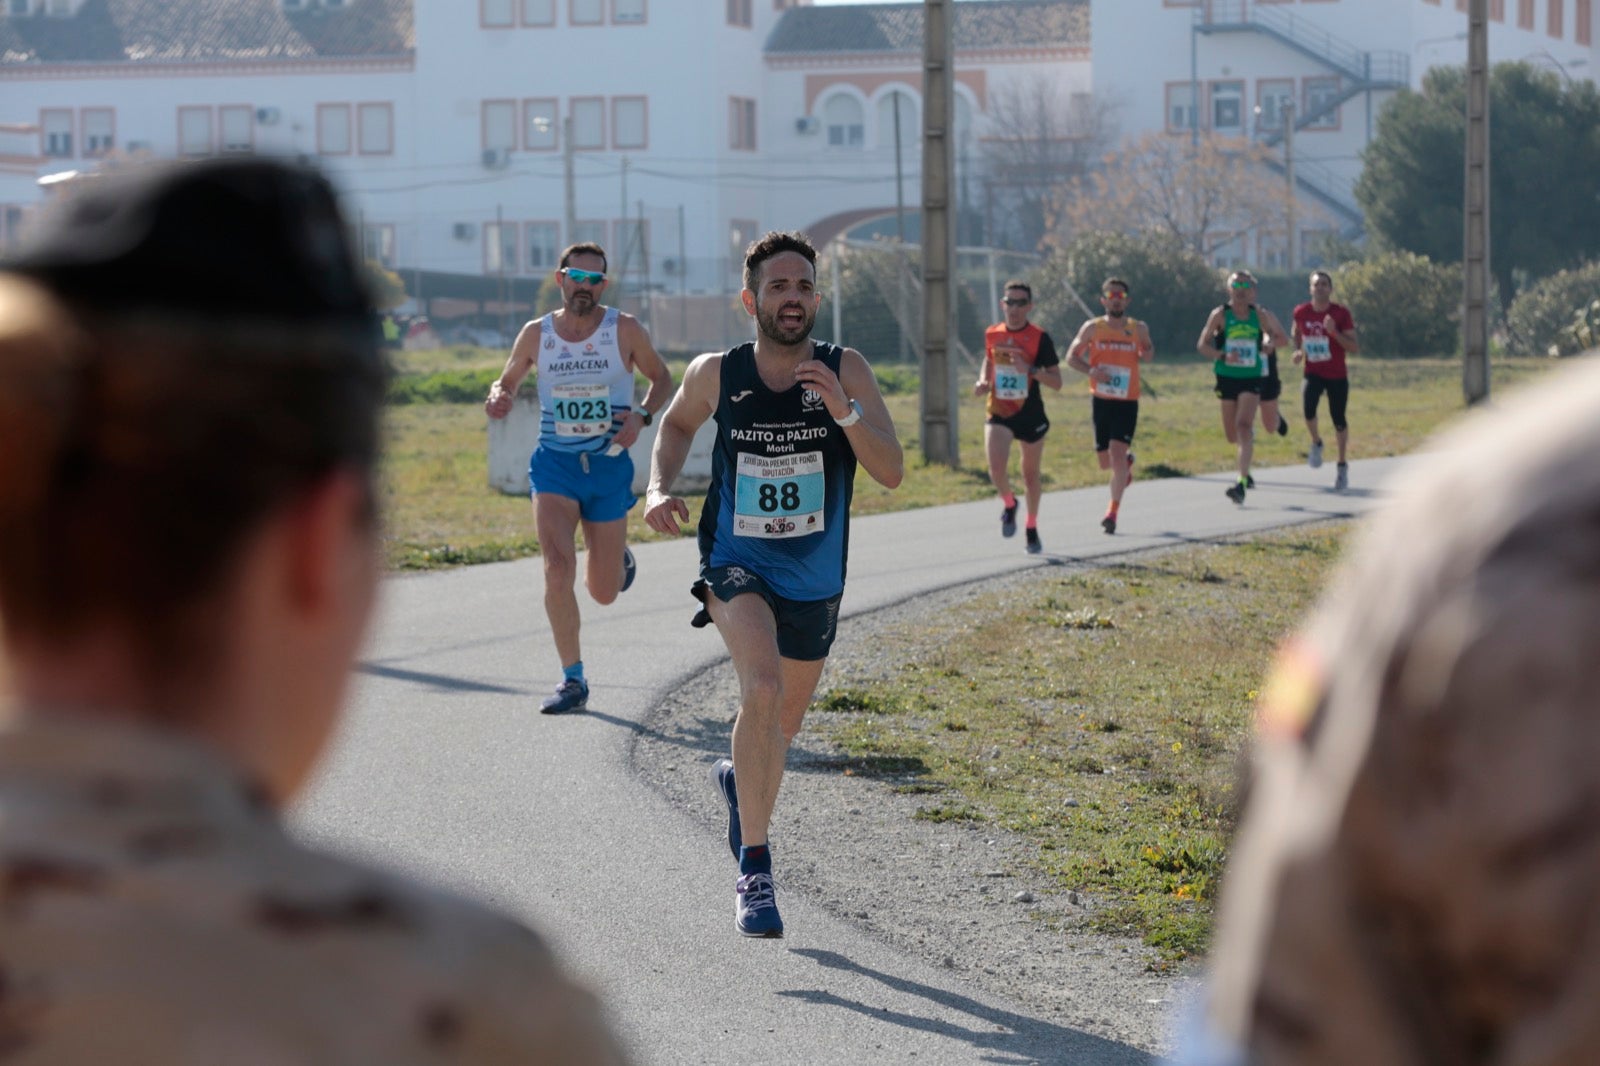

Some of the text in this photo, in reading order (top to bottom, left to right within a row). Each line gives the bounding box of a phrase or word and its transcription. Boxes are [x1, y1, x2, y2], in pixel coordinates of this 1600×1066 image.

[548, 359, 609, 373] MARACENA
[1001, 376, 1017, 390] 22
[556, 400, 608, 420] 1023
[731, 427, 828, 442] PAZITO a PAZITO
[766, 443, 795, 453] Motril
[770, 458, 790, 468] PREMIO
[799, 454, 817, 465] FONDO
[762, 467, 795, 477] DIPUTACIÓN
[758, 481, 801, 513] 88
